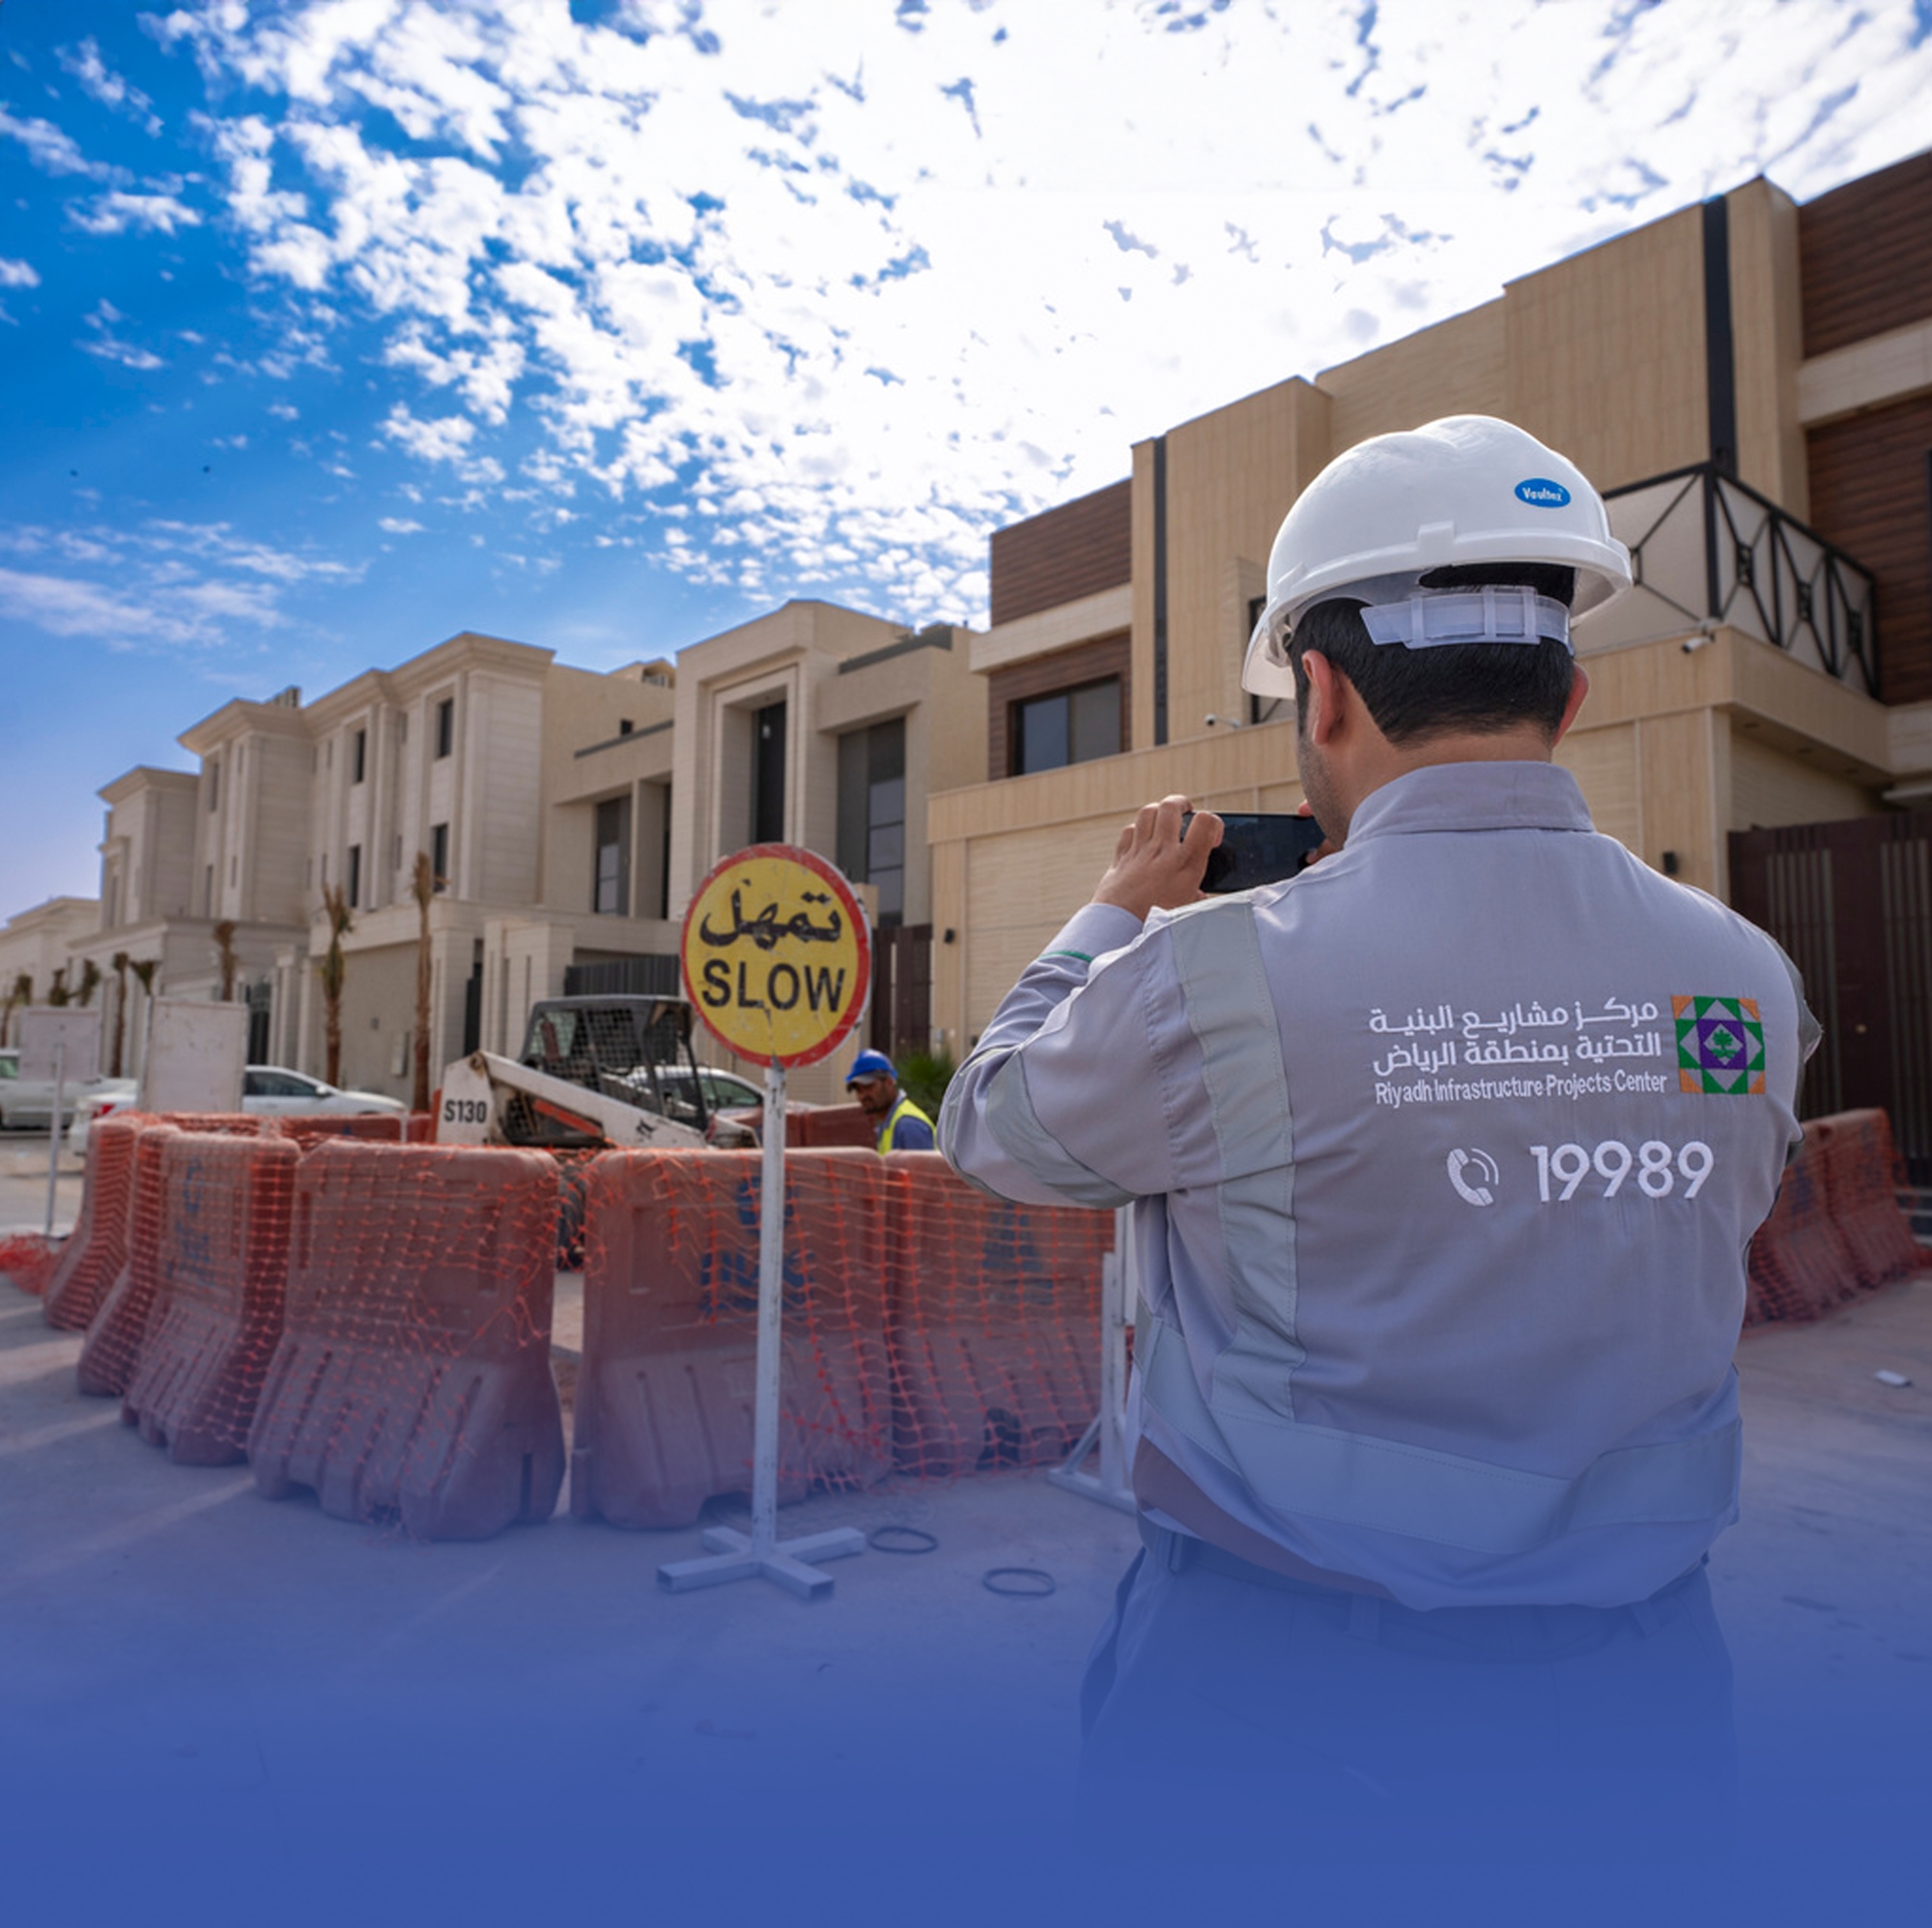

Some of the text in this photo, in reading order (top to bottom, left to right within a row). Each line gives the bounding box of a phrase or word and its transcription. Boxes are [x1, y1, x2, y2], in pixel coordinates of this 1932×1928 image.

[699, 878, 842, 950] تمهل
[701, 958, 845, 1012] SLOW
[1369, 996, 1659, 1038] مركز مشاريع البنية
[1373, 1031, 1662, 1076] التحتية بمنطقة الرياض
[443, 1099, 488, 1123] S130
[1375, 1068, 1667, 1109] Riyadh Infrastructure Projects Center
[1529, 1140, 1715, 1203] 19989
